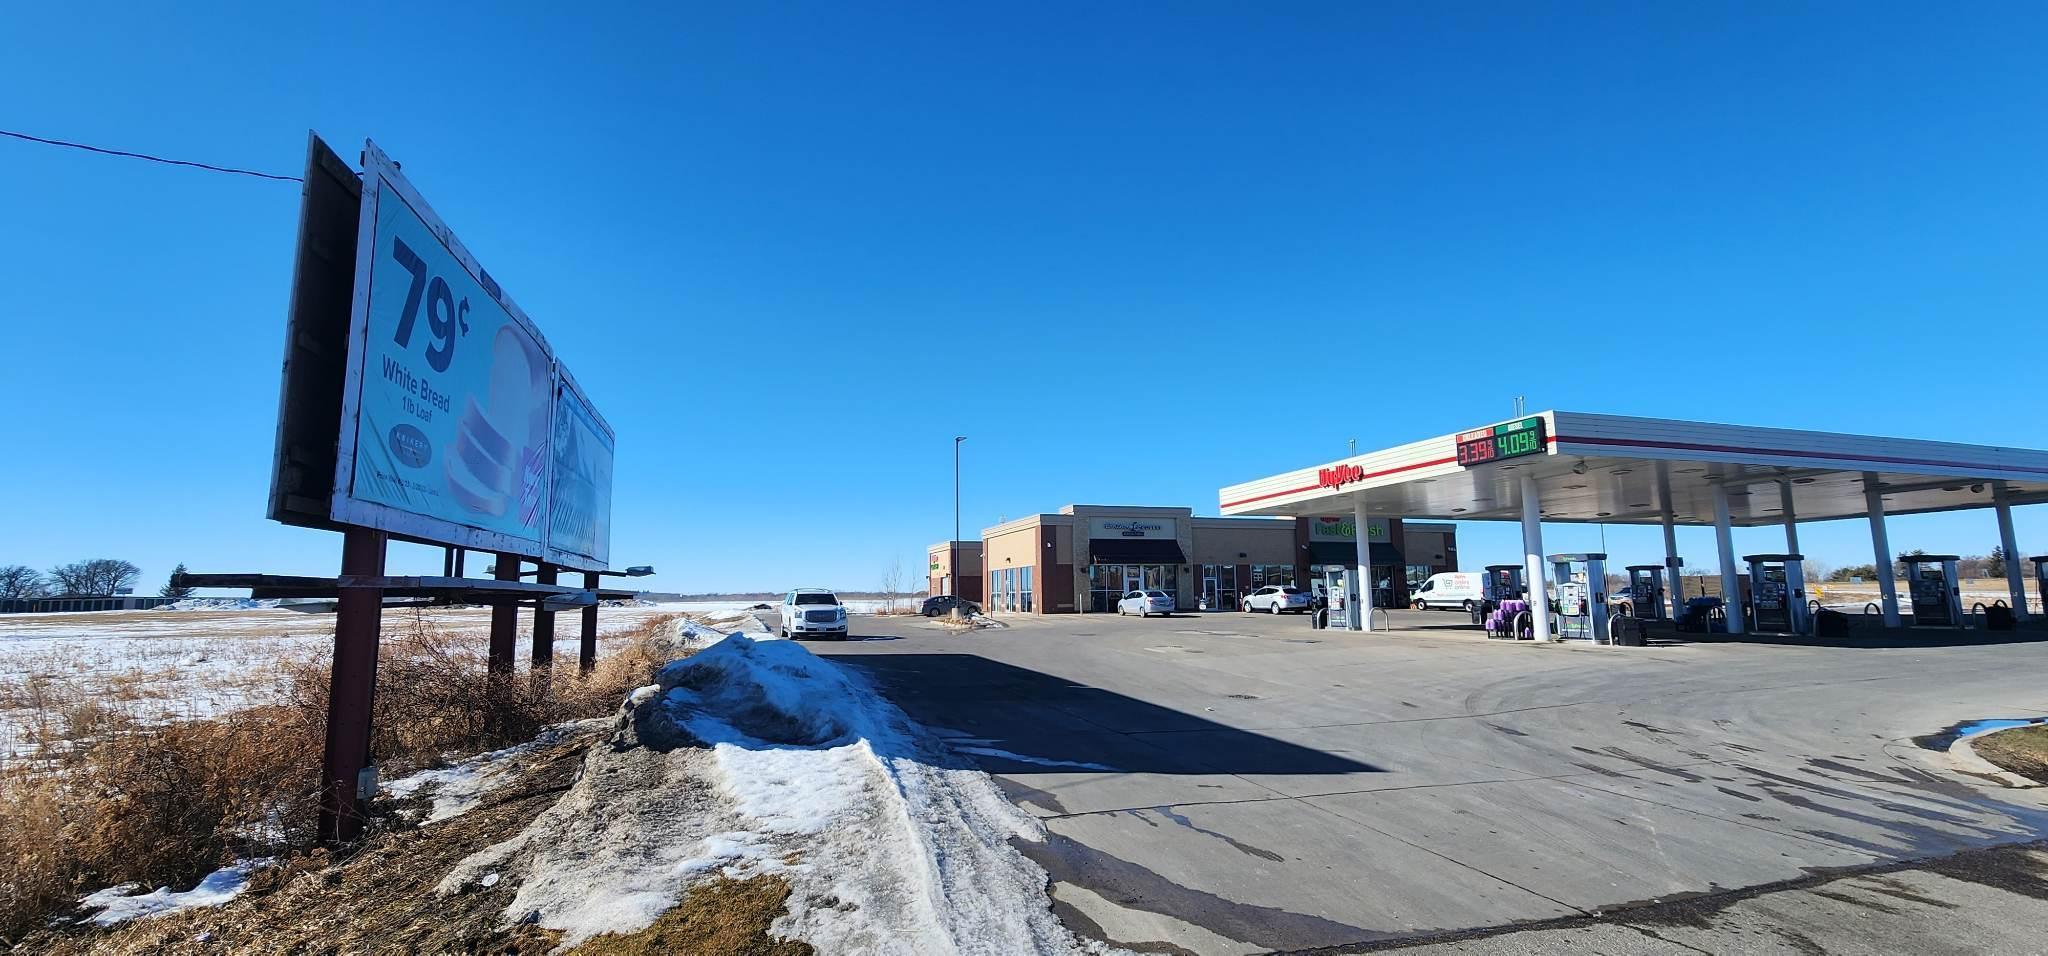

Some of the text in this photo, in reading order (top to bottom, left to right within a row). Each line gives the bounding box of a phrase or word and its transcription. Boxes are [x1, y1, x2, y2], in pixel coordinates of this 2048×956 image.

[383, 353, 450, 414] White Bread
[402, 396, 433, 424] 1lb Loaf
[1460, 441, 1488, 464] 3.39
[1498, 432, 1529, 455] 4.09
[1351, 523, 1384, 536] Fesh
